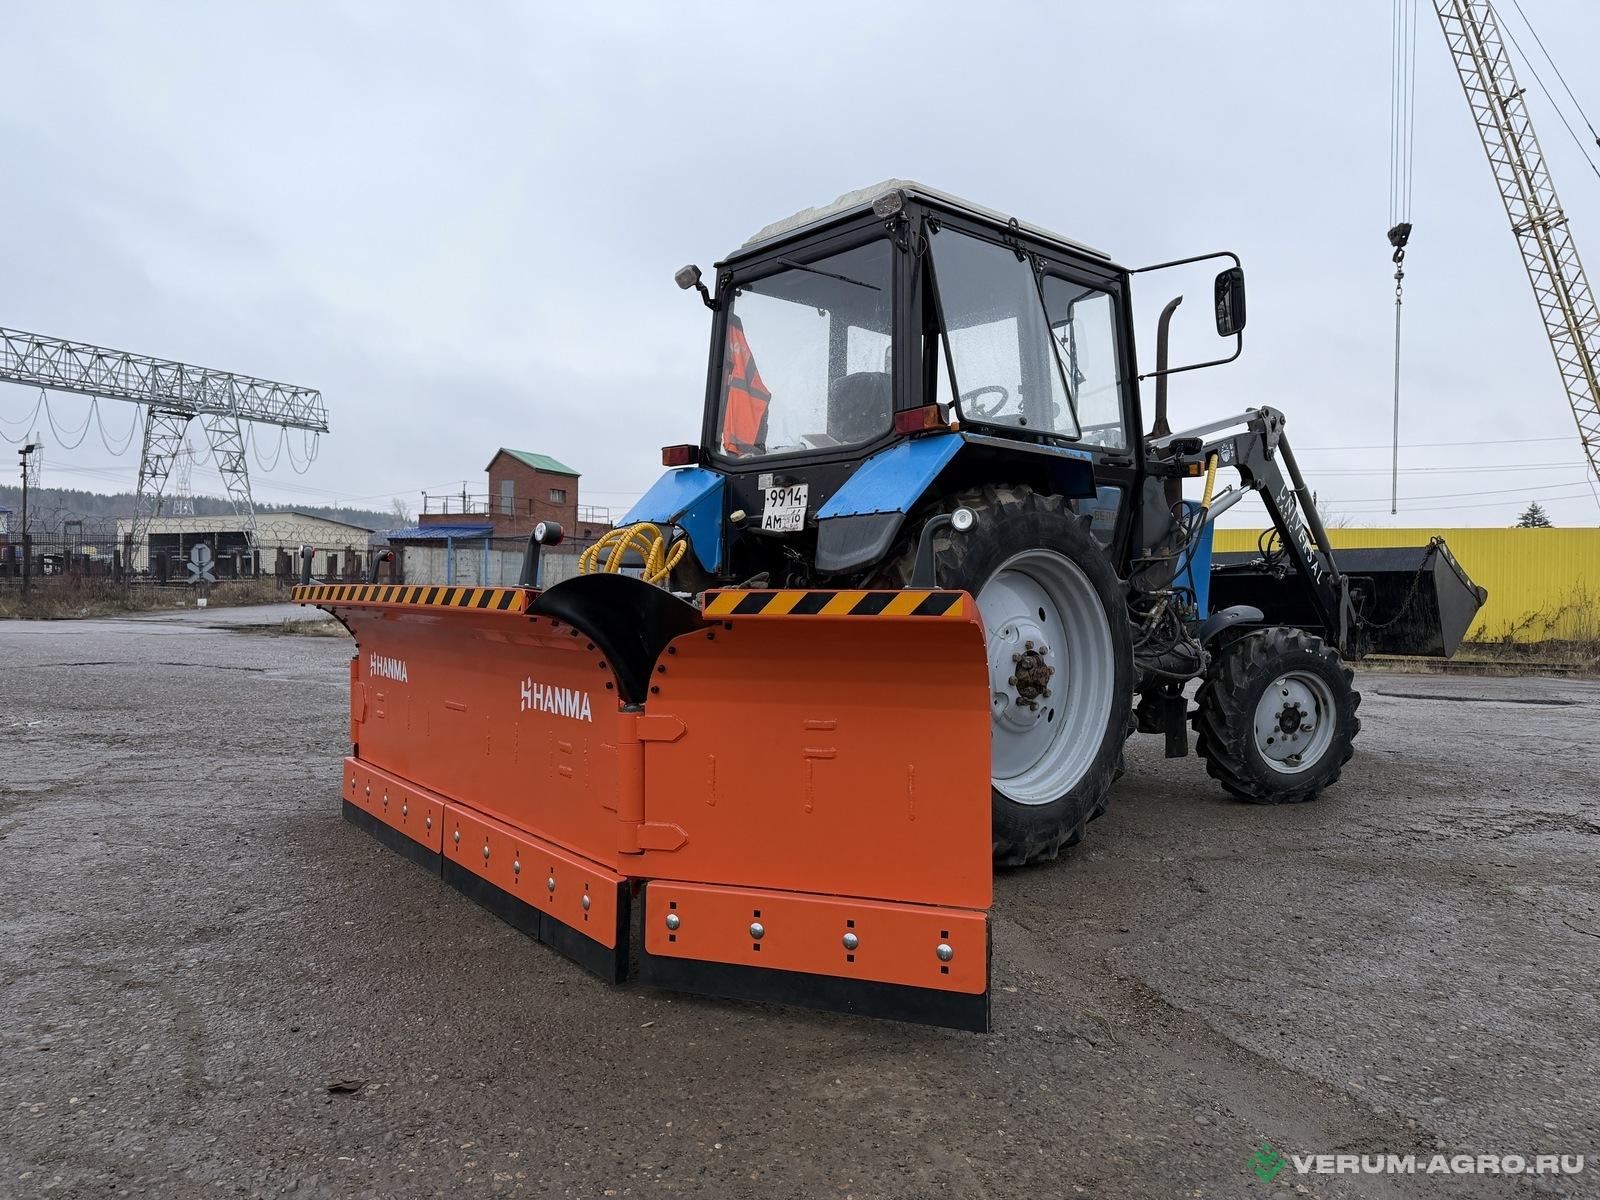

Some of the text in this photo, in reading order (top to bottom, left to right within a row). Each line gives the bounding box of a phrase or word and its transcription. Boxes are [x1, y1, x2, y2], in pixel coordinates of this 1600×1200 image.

[770, 487, 801, 508] 9914
[1280, 483, 1323, 585] UNIVERSAL
[376, 655, 408, 683] HANMA
[533, 682, 592, 723] HANMA
